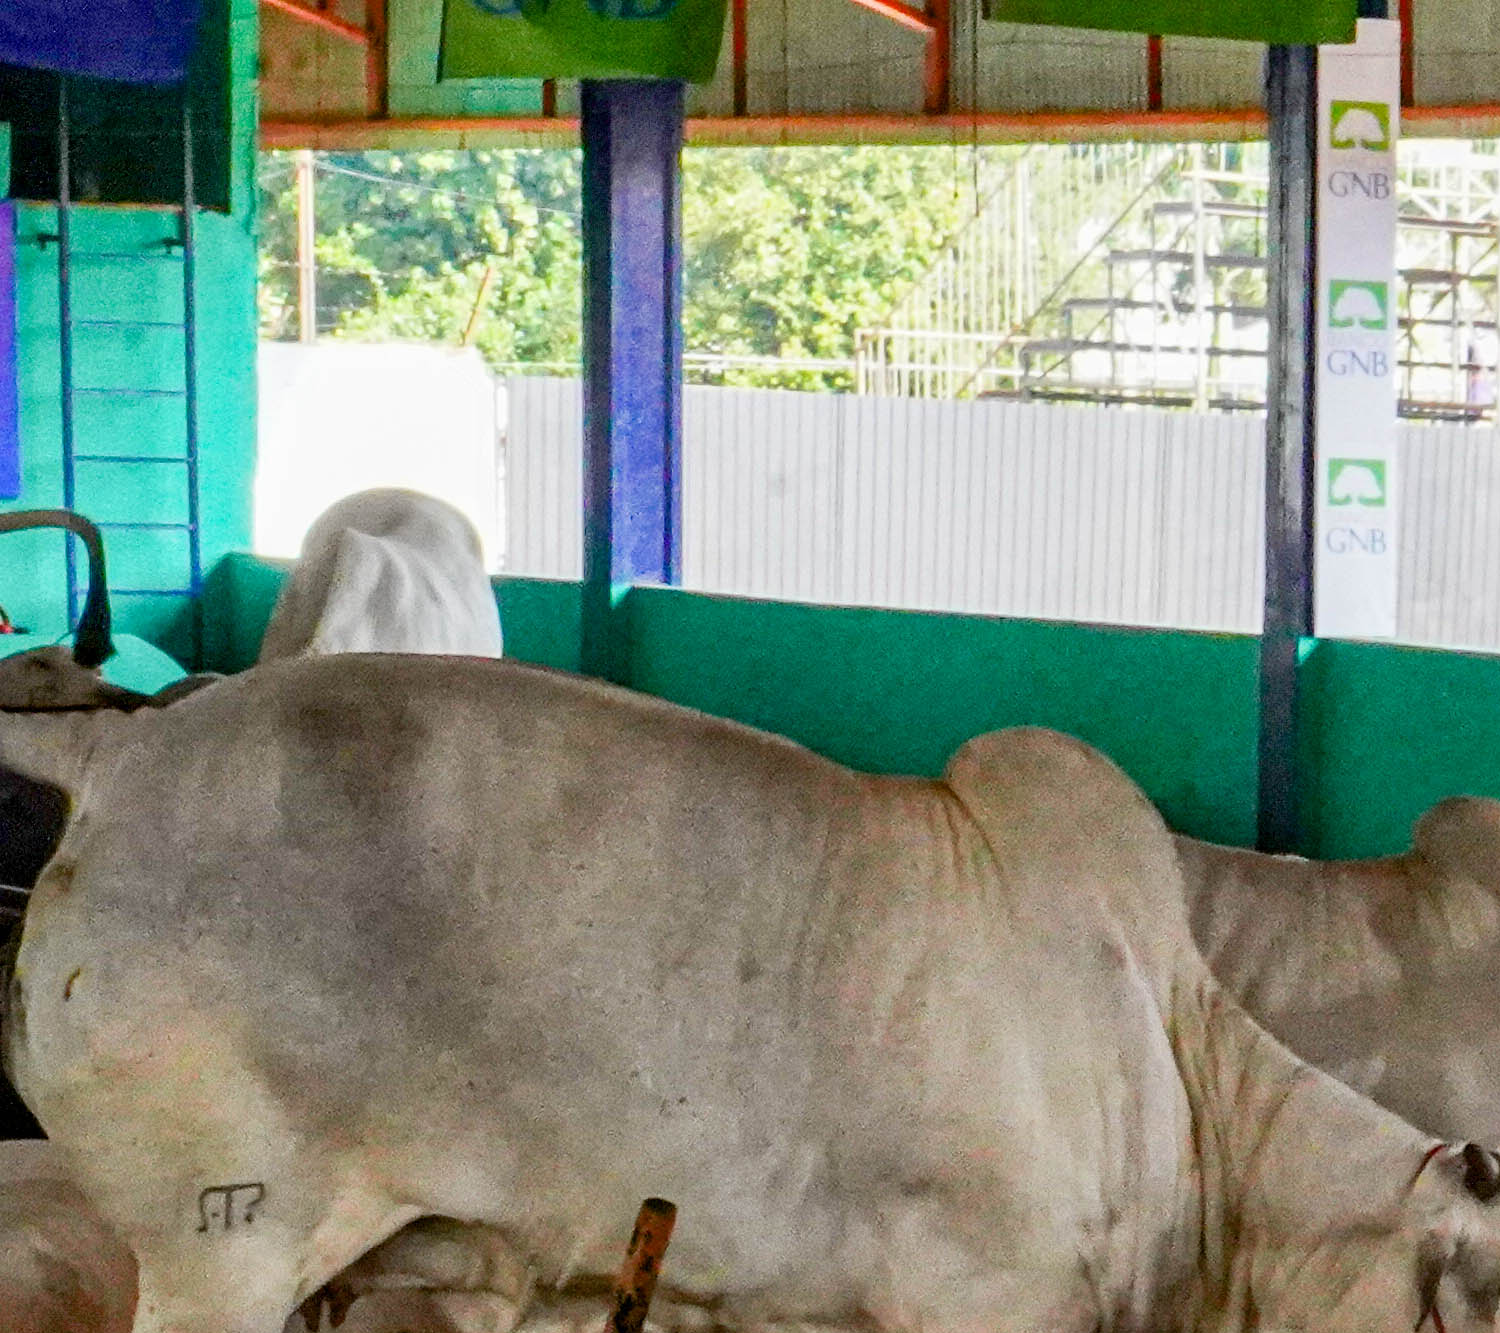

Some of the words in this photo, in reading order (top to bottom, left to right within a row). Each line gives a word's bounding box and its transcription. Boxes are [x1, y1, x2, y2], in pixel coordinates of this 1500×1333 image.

[1328, 171, 1390, 200] GNB
[1327, 348, 1389, 377] GNB
[1326, 527, 1387, 554] GNB
